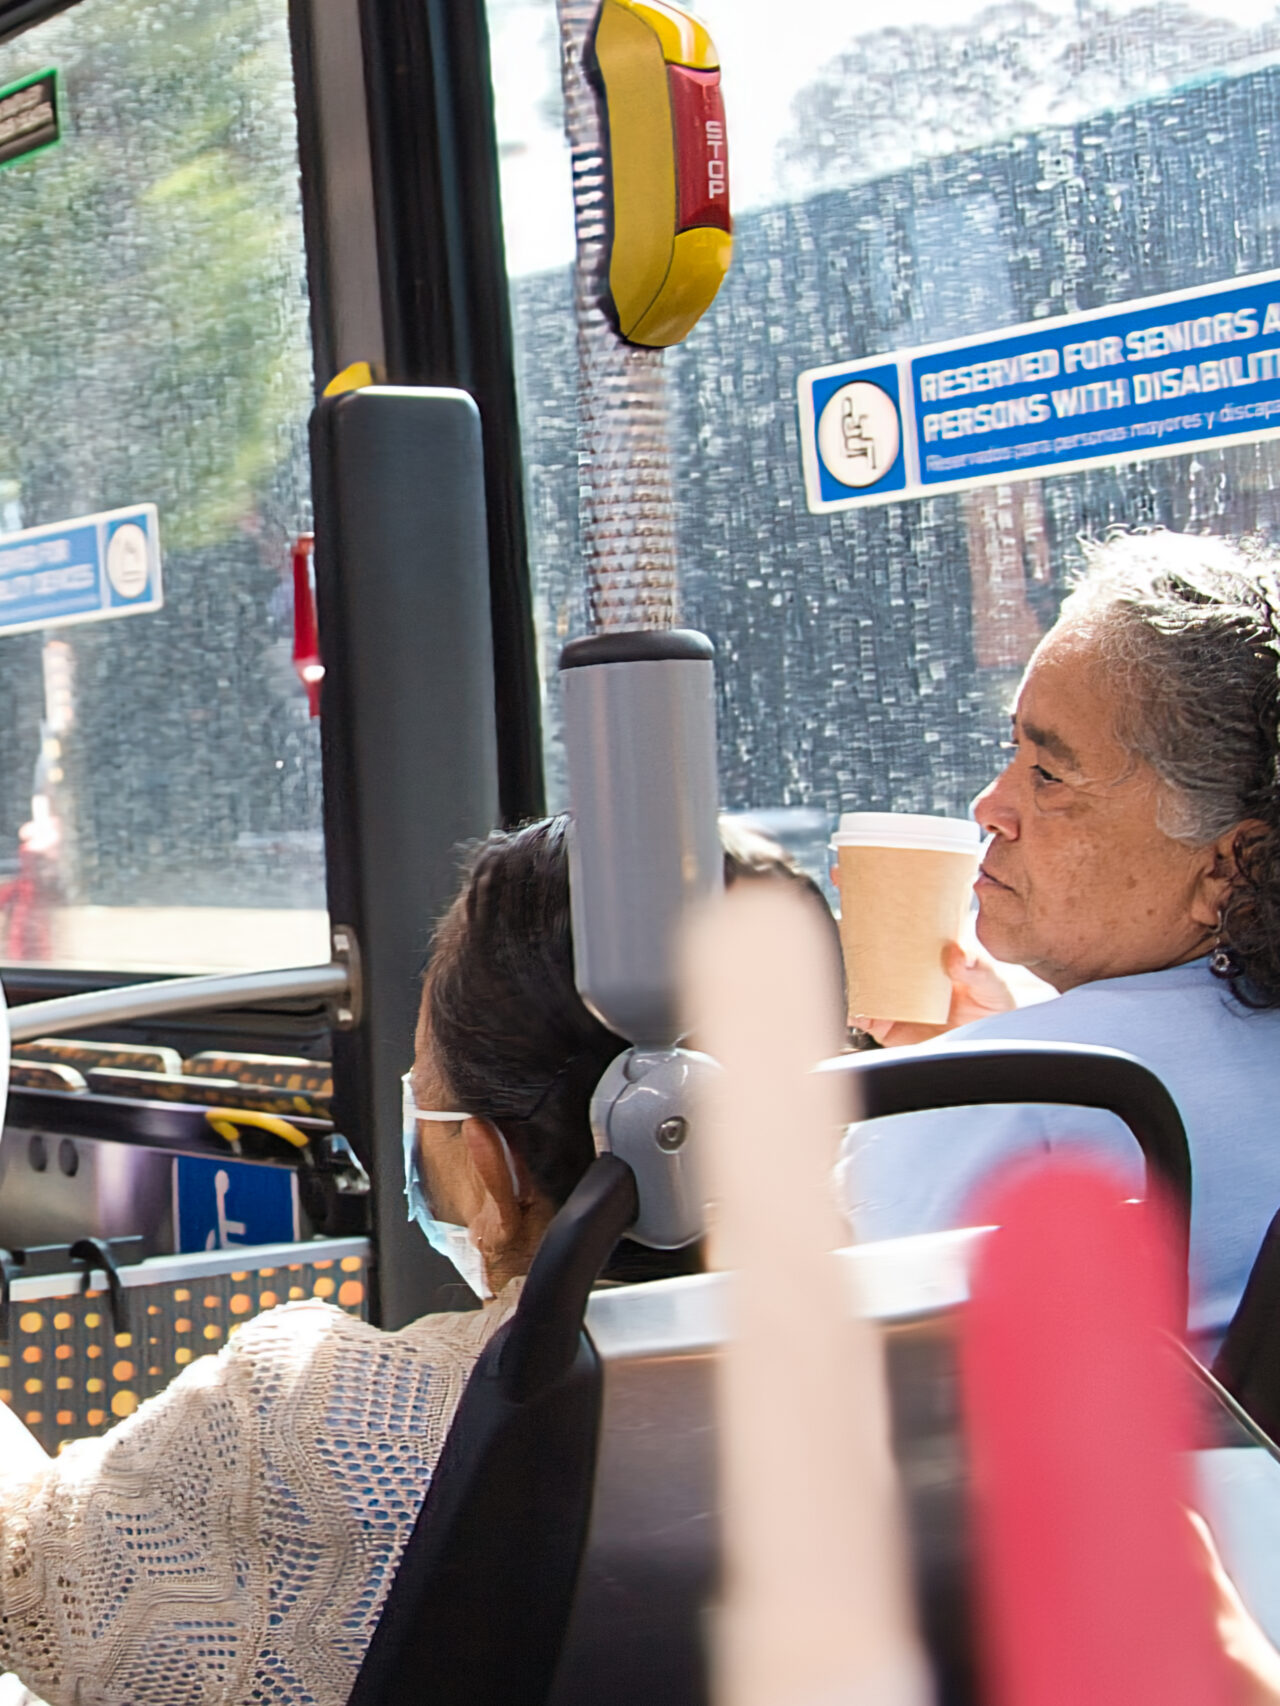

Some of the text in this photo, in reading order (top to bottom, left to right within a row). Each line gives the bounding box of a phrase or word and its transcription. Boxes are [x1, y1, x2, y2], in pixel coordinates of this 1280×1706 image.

[705, 120, 725, 199] STOP
[920, 349, 1060, 403] RESERVED
[1062, 336, 1126, 375] FOR
[1125, 307, 1259, 362] SENIORS
[923, 393, 1052, 444] PERSONS
[1050, 378, 1131, 419] WITH
[1130, 413, 1202, 439] mayores
[1201, 411, 1215, 430] y
